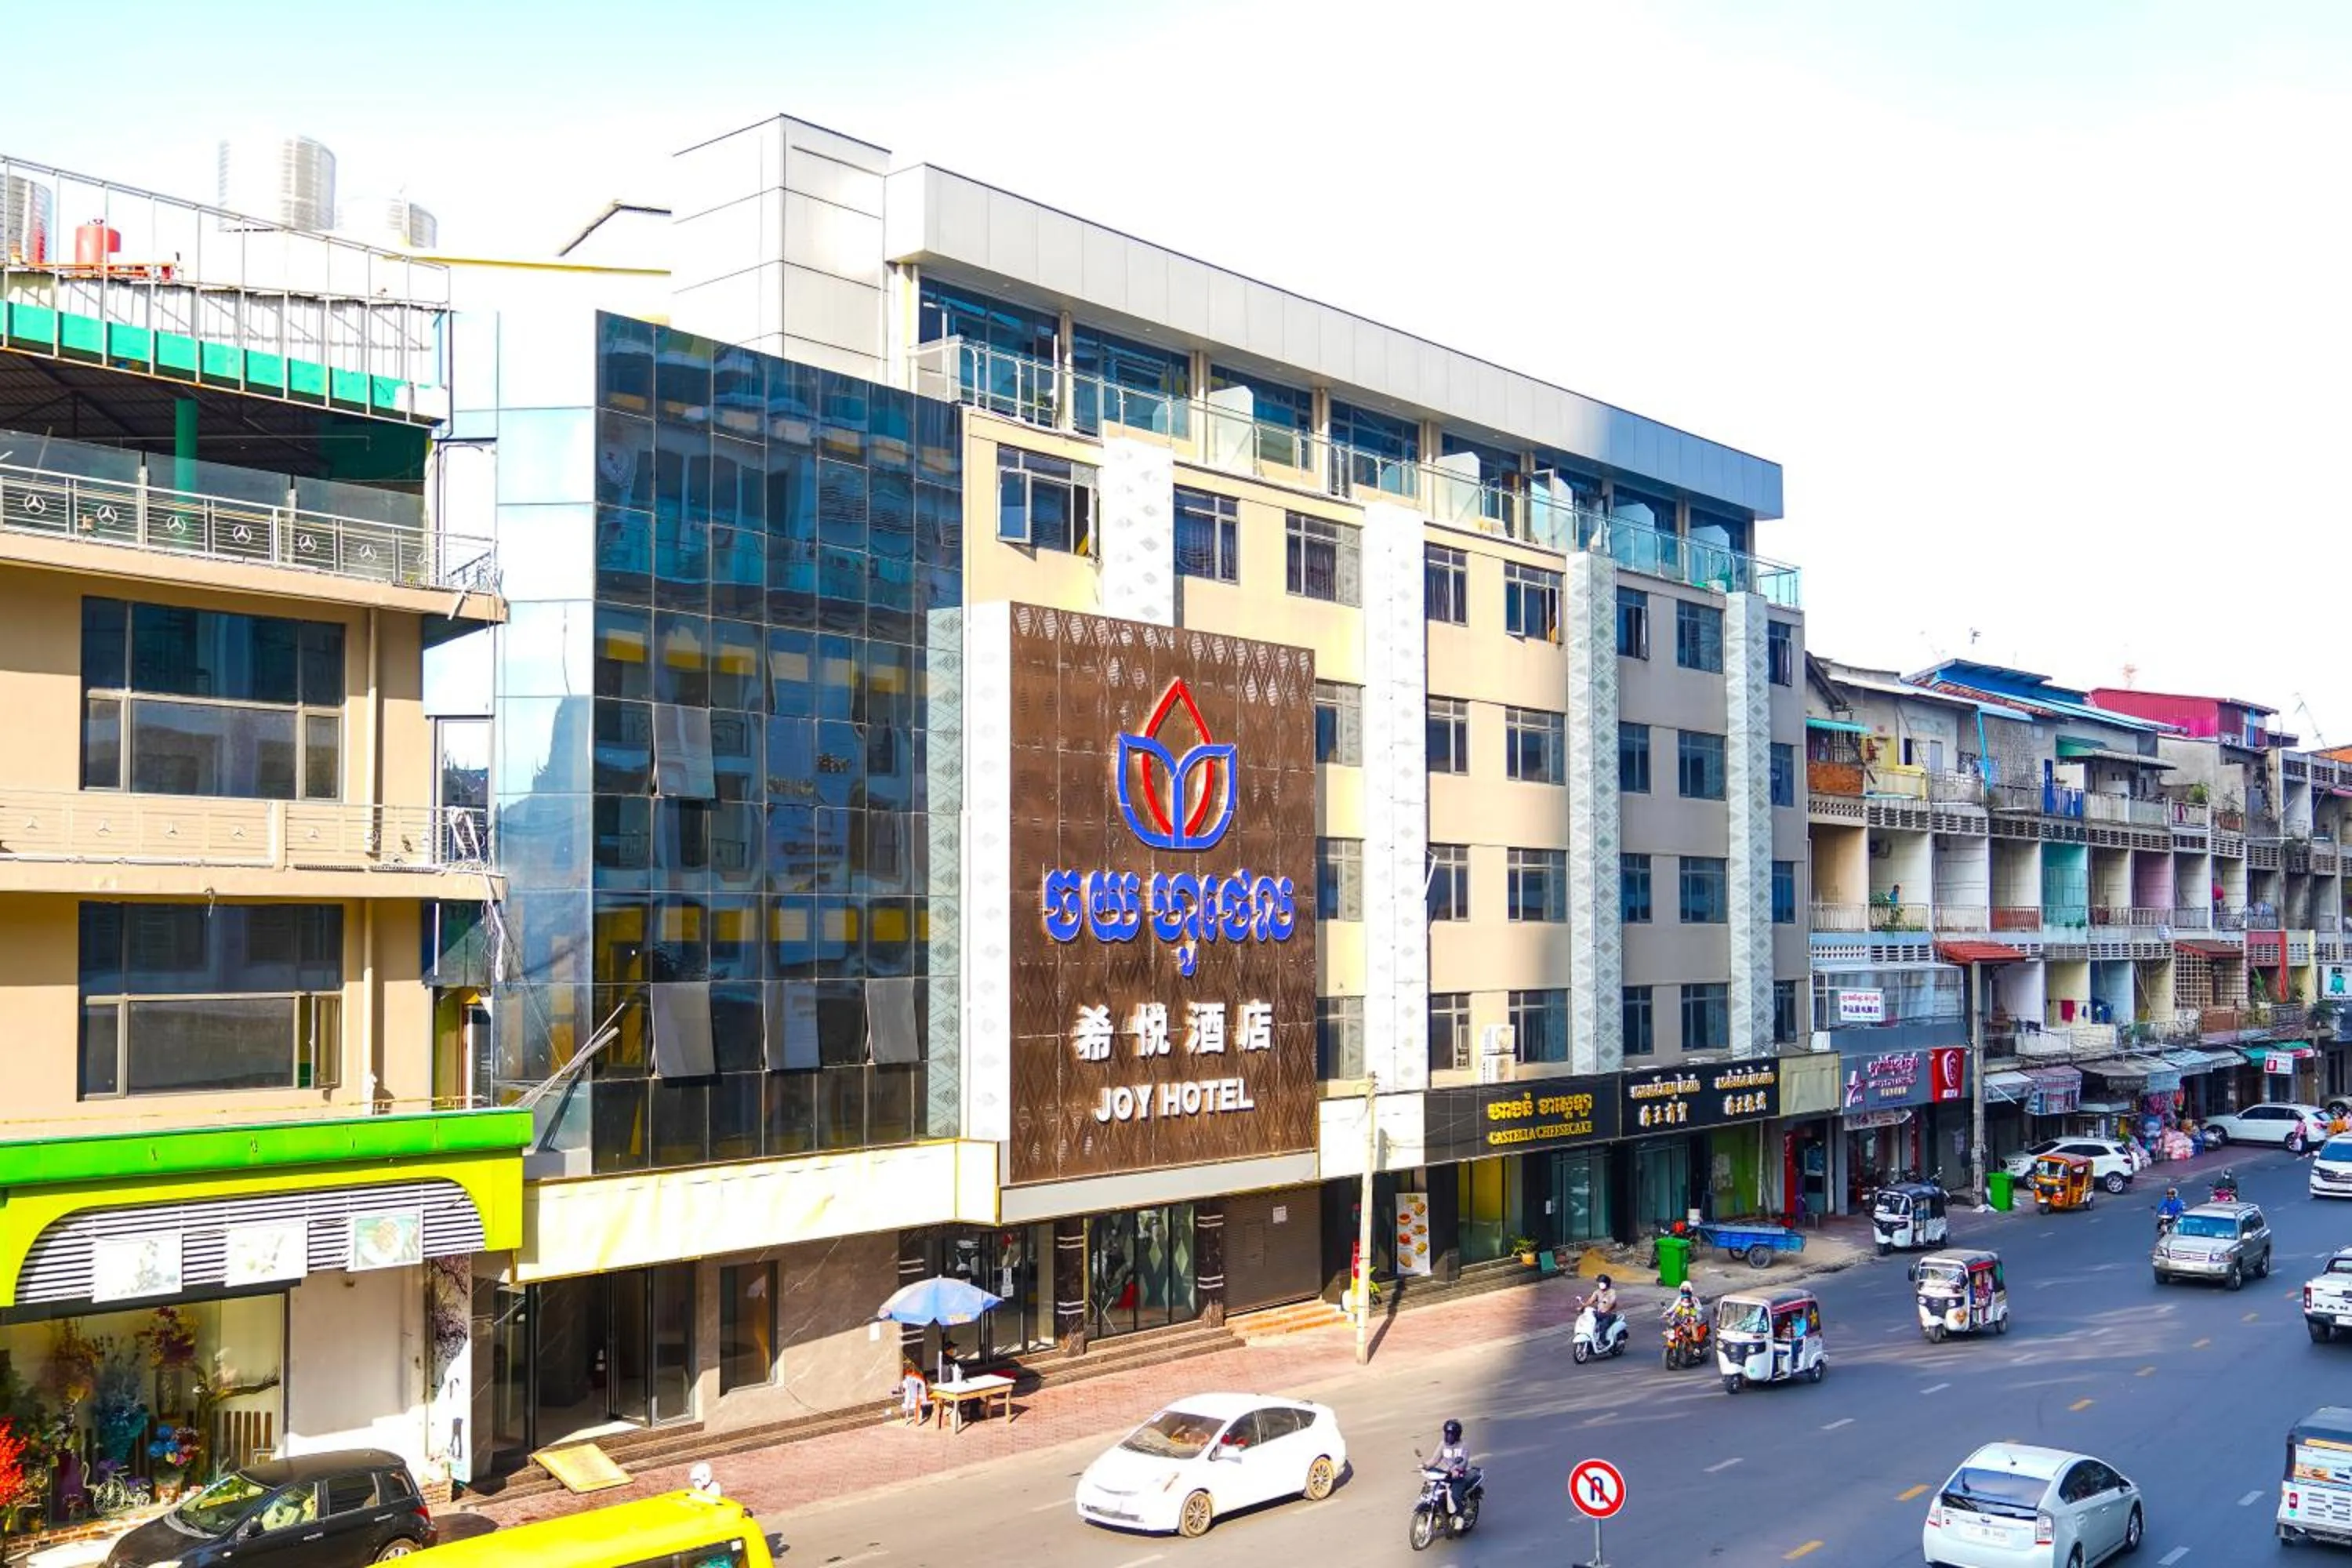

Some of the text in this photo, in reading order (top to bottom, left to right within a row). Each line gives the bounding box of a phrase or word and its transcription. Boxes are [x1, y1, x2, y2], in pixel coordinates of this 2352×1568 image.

[1075, 1000, 1272, 1062] 希悦酒店
[1094, 1078, 1254, 1123] JOY HOTEL
[1488, 1121, 1592, 1145] CASTELLA CHEESECAKE
